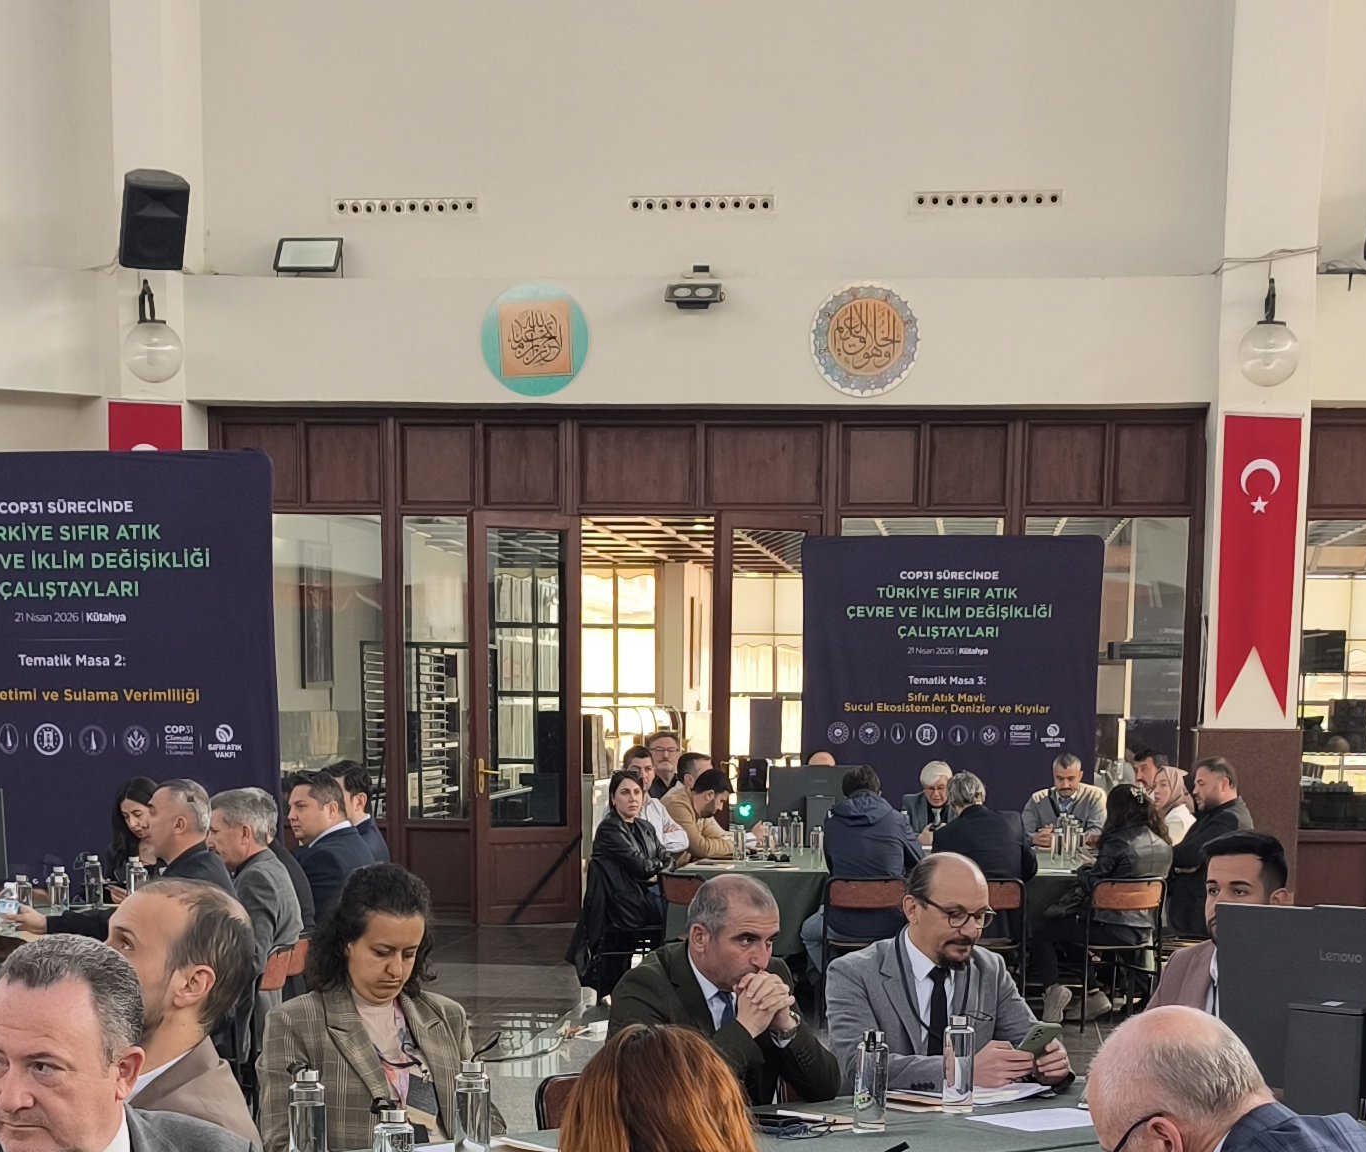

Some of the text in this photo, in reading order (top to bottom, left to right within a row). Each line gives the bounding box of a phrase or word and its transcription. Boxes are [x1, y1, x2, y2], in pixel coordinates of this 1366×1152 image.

[47, 499, 134, 514] SÜRECİNDE
[59, 525, 110, 541] SIFIR
[115, 524, 162, 540] ATIK
[0, 553, 26, 570] VE
[31, 549, 84, 569] İKLİM
[91, 547, 211, 572] DEĞİŞİKLİĞİ
[899, 569, 1000, 580] COP31 SÜRECİNDE
[0, 580, 140, 601] ÇALIŞTAYLARI
[876, 585, 1018, 599] TÜRKİYE SIFIR ATIK
[14, 612, 127, 624] 21 Nisan 2026 Kütahya
[846, 603, 1053, 620] ÇEVRE VE İKLİM DEĞİŞİKLİĞİ
[897, 625, 999, 640] ÇALIŞTAYLARI
[18, 654, 127, 667] Tematik Masa 2:
[908, 675, 987, 685] Tematik Masa 3:
[42, 690, 59, 702] ve
[64, 688, 119, 702] Sulama
[123, 688, 201, 704] Verimliliği
[907, 692, 986, 703] Sıfır Atık Mavi:
[844, 701, 1050, 715] Sucul Ekosistemler, Denizler ve Kıyılar
[1319, 949, 1363, 964] Lenovo
